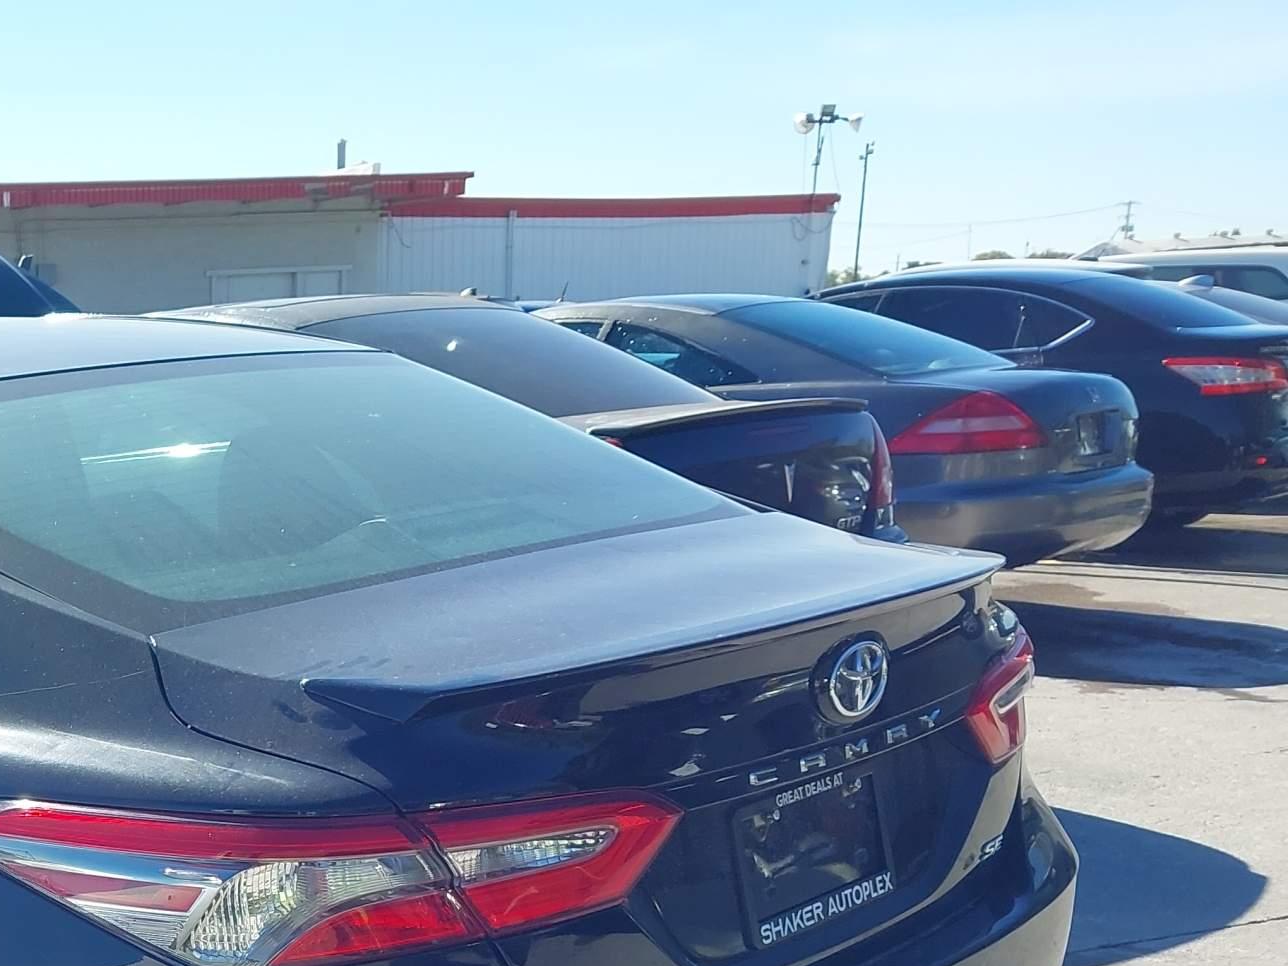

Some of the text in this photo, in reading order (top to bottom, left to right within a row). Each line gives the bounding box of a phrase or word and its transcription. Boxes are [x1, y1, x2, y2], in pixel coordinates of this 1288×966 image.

[749, 708, 942, 786] CAMRY
[775, 772, 844, 807] GREAT DEALS AT
[981, 834, 1004, 860] SE
[761, 872, 894, 945] SHAKER AUTOPLEX
